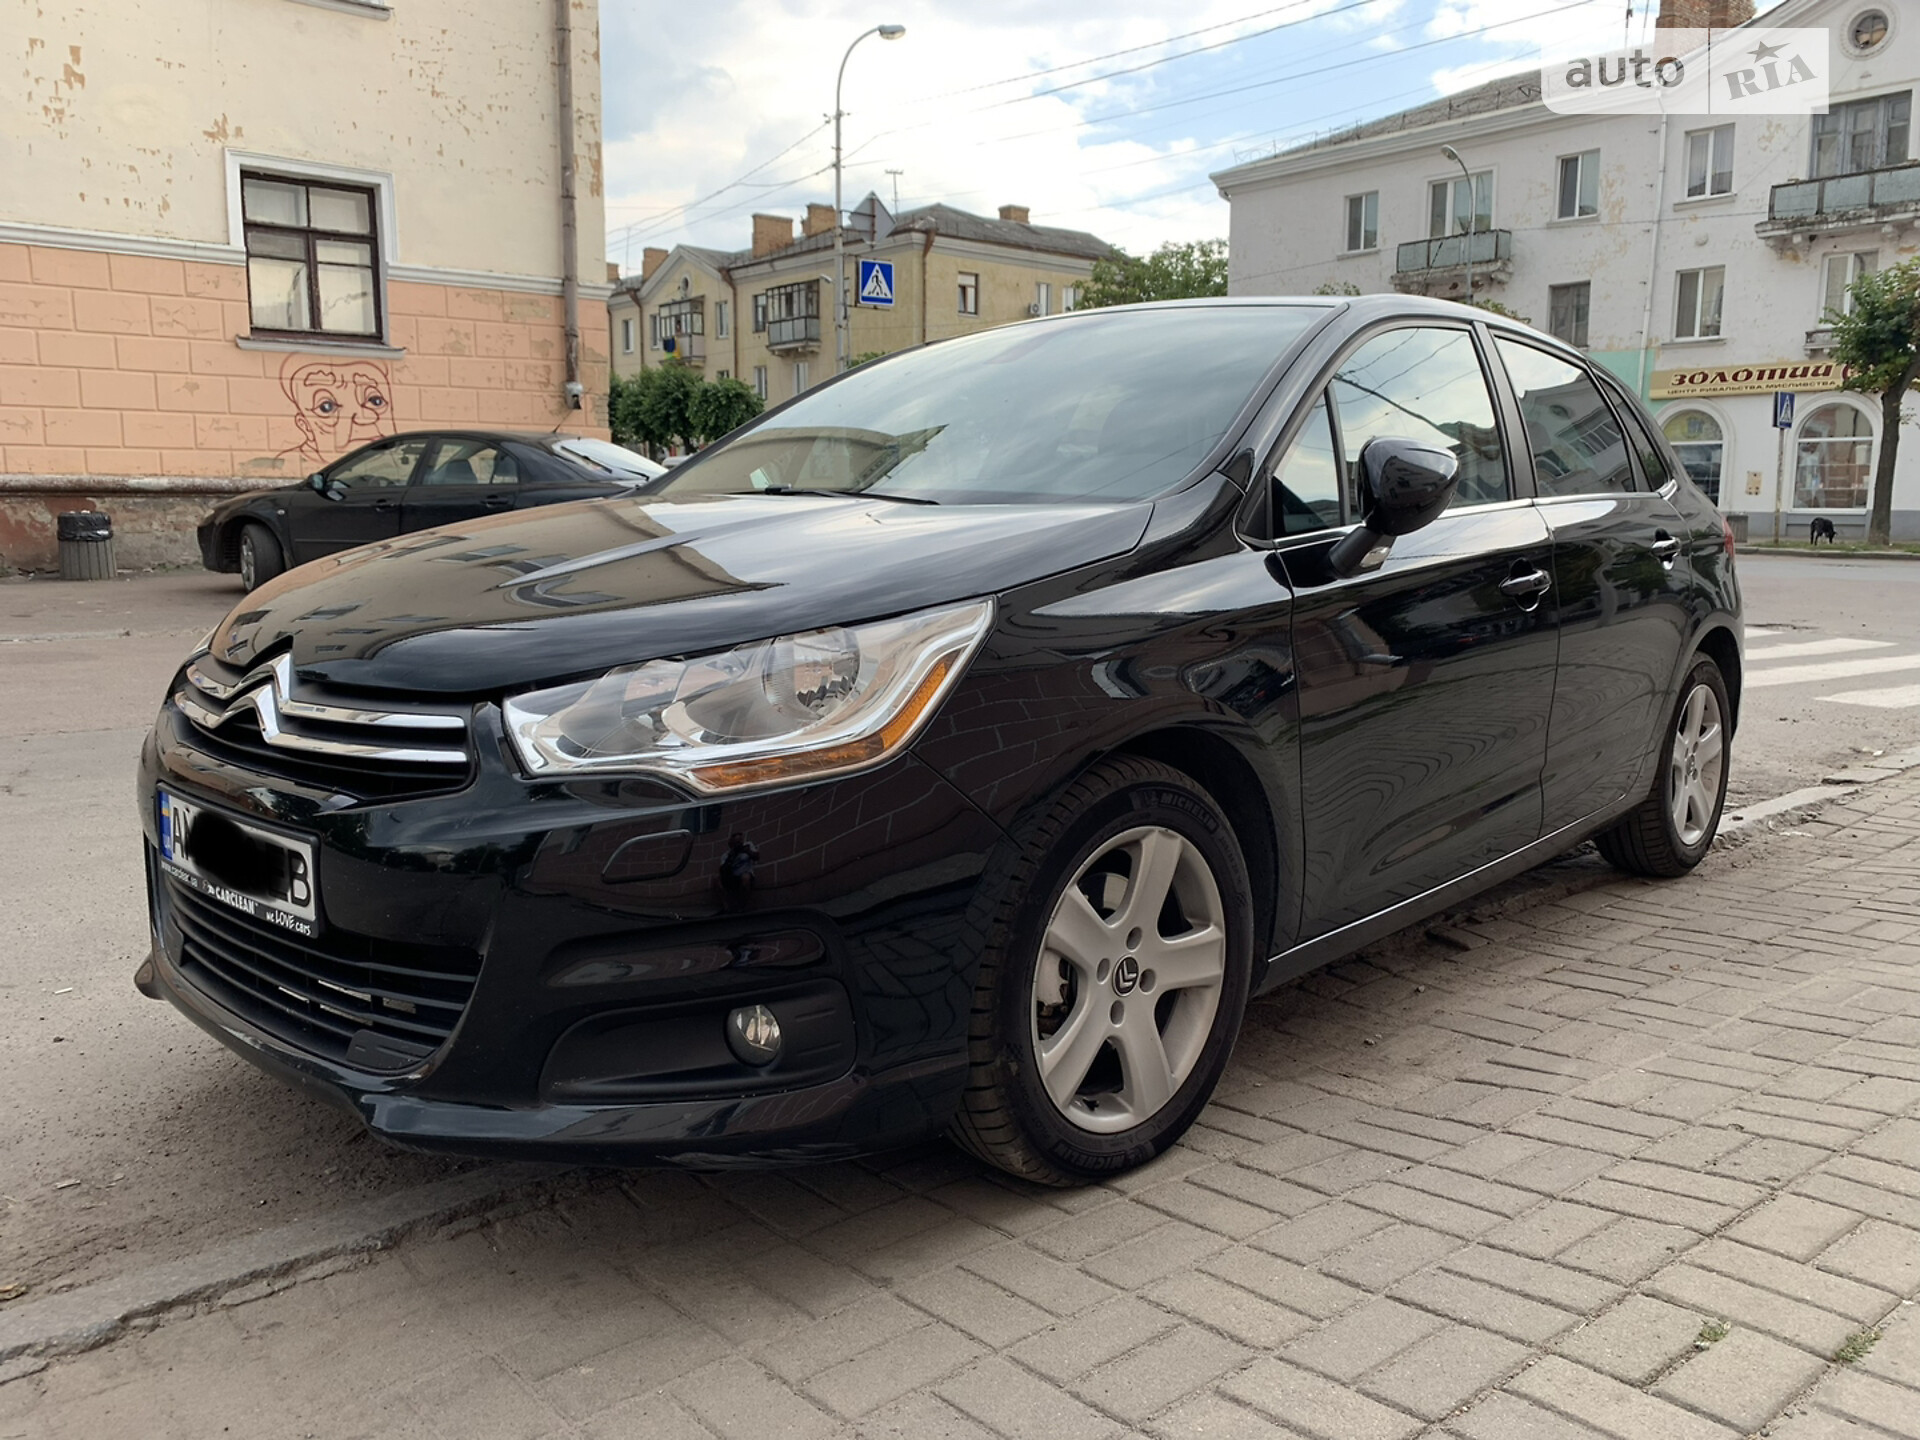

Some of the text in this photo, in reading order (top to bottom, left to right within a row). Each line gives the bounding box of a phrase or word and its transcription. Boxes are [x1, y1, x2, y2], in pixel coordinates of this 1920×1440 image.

[1160, 791, 1218, 833] MICHELIN
[275, 910, 295, 930] LOVE
[295, 921, 311, 936] cars
[1054, 1143, 1126, 1169] MICHELIN
